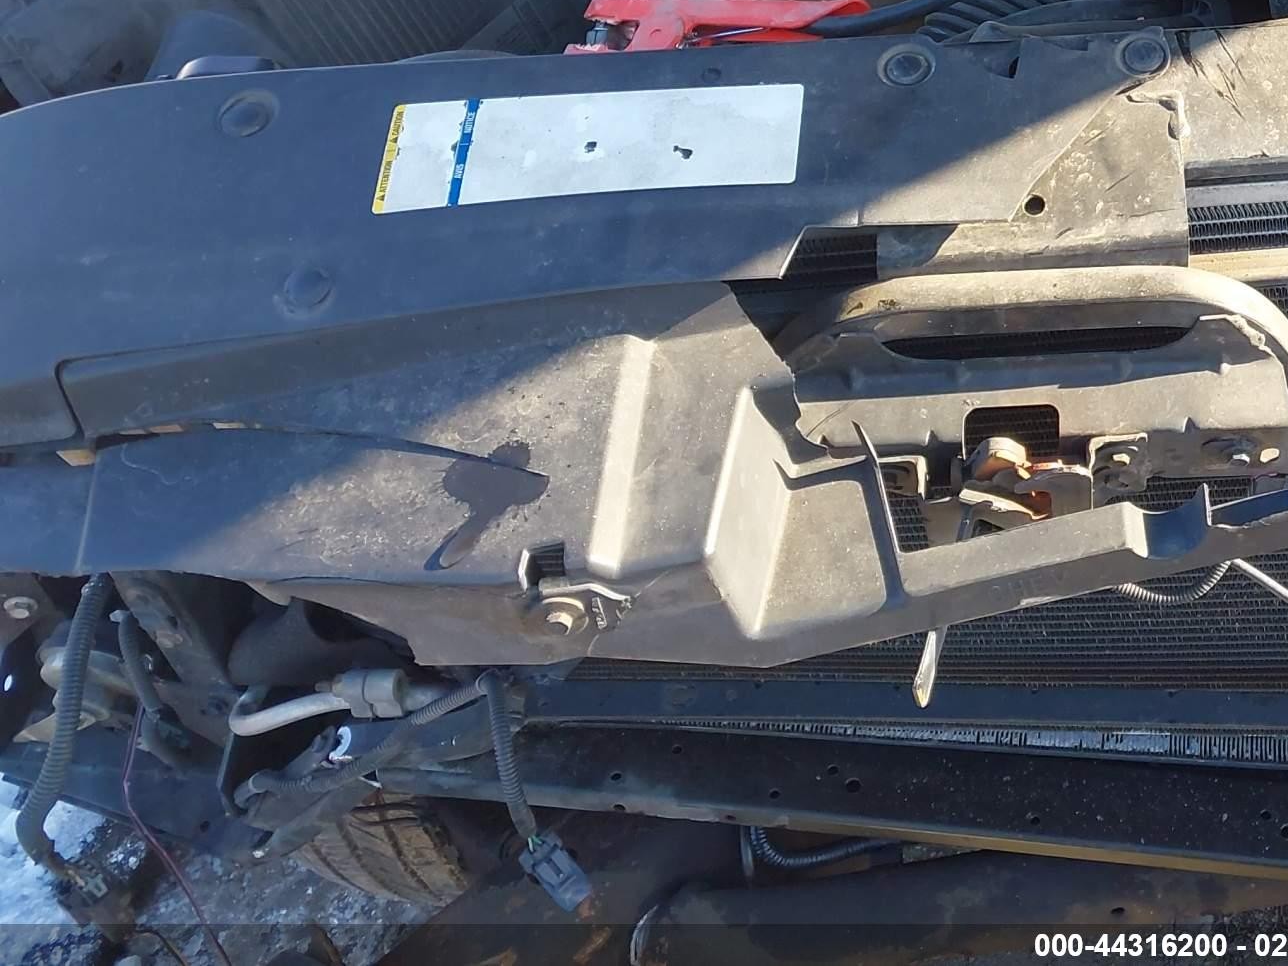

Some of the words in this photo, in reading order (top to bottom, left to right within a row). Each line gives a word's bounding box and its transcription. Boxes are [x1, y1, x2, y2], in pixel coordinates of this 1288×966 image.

[379, 160, 393, 193] ATTENTION
[392, 111, 404, 136] CAUTION
[453, 163, 465, 179] AVIS
[464, 112, 475, 133] NOTICE
